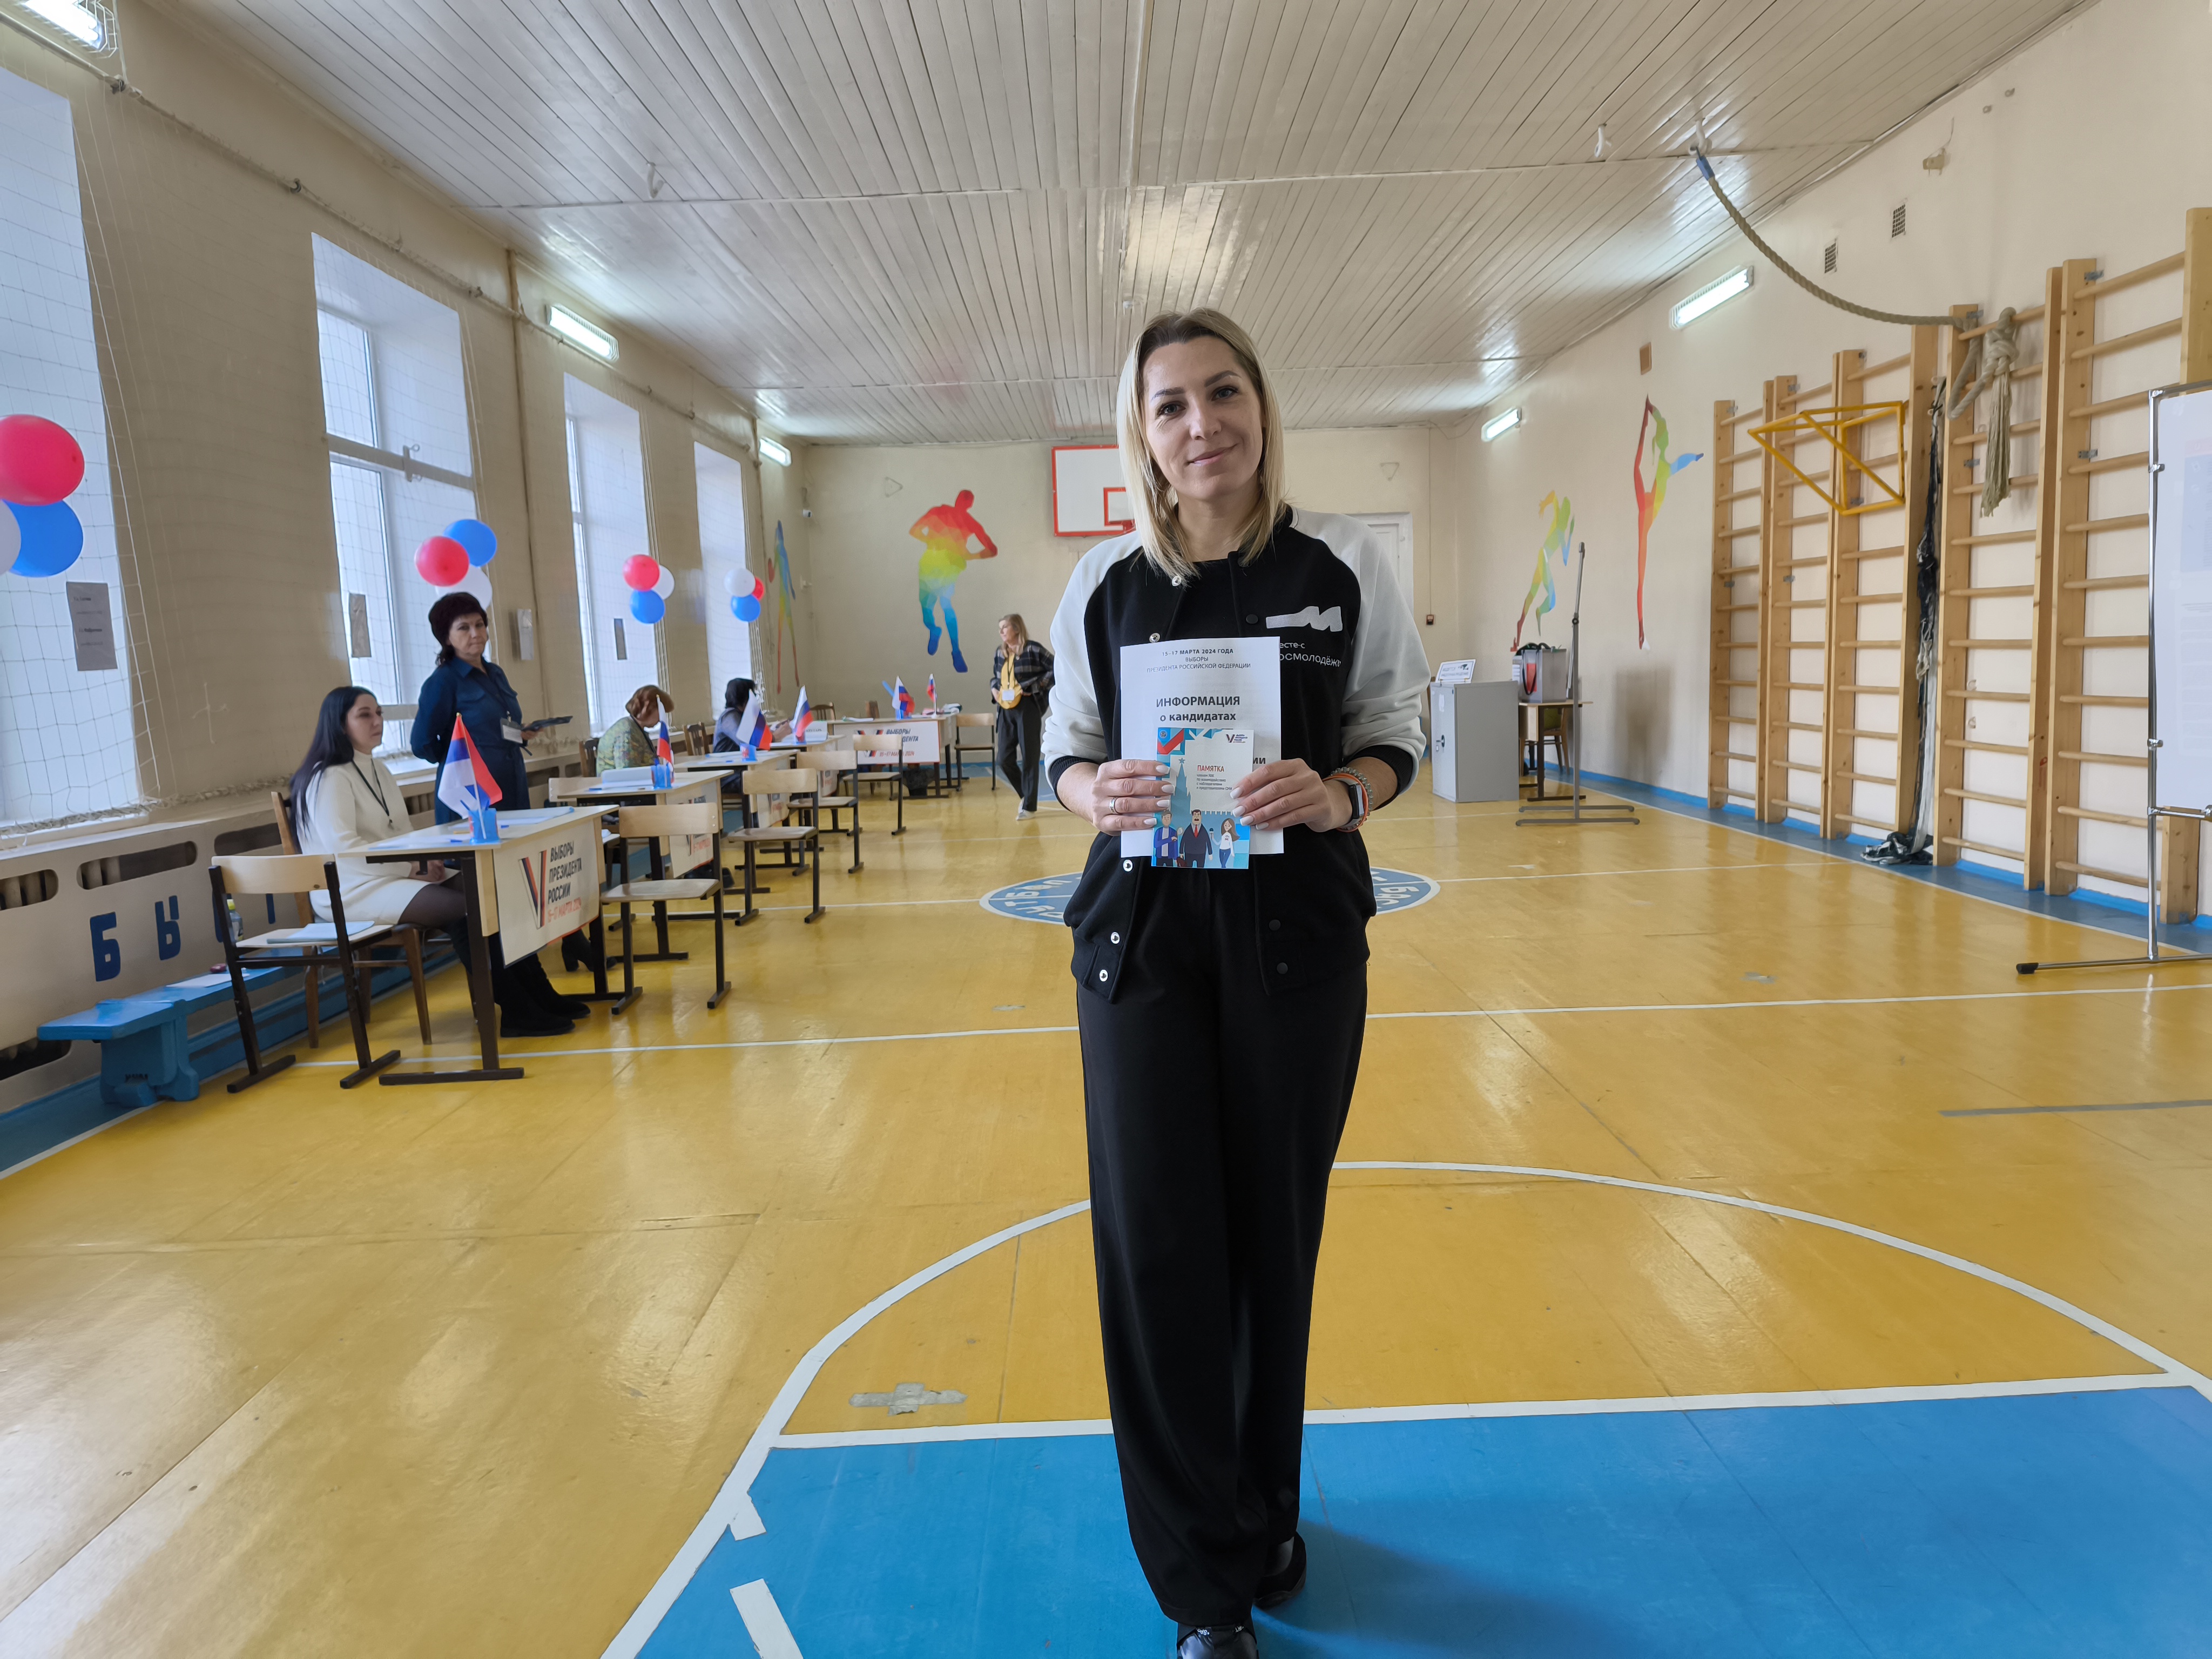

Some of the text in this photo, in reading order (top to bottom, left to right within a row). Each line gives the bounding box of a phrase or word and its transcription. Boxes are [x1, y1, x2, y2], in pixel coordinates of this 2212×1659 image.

[1280, 653, 1341, 667] осмолодёжь
[1156, 696, 1240, 707] ИНФОРМАЦИЯ
[1169, 713, 1236, 722] кандидатах
[550, 840, 575, 862] ВЫБОРЫ
[549, 858, 582, 883] ПРЕЗИДЕНТА
[548, 882, 571, 905] РОССИИ
